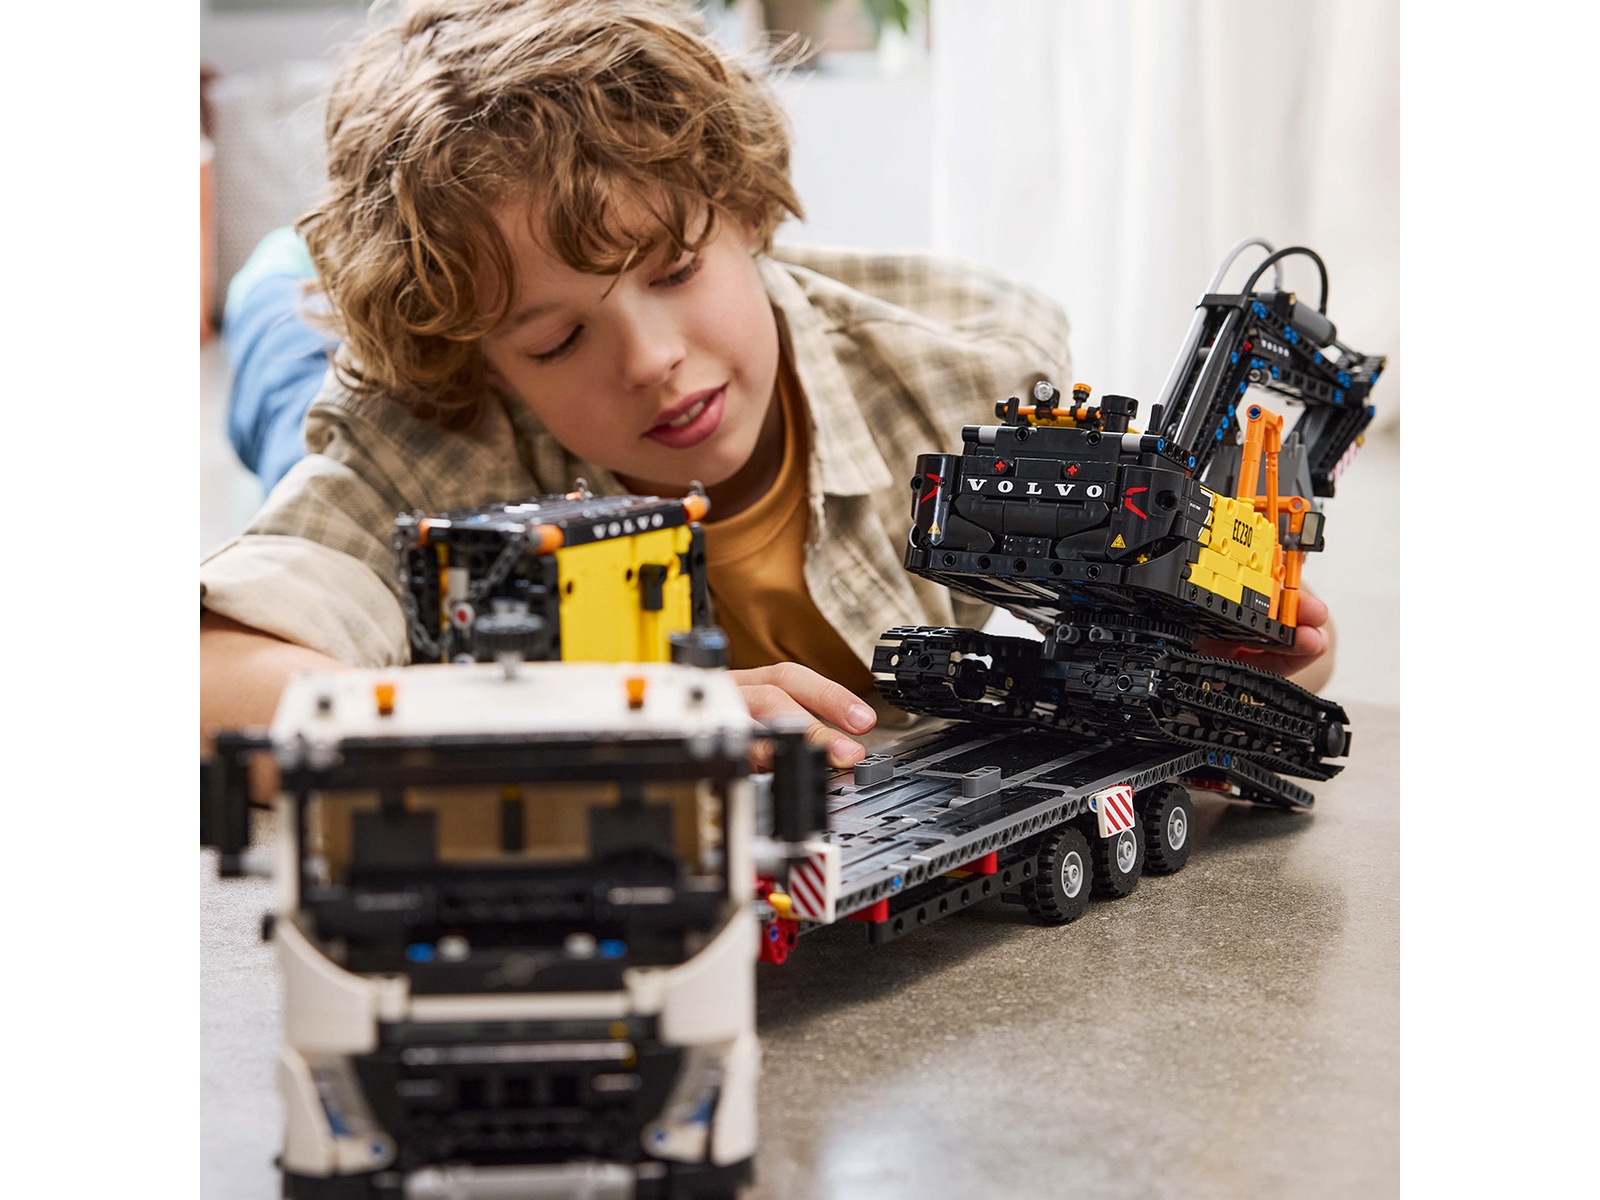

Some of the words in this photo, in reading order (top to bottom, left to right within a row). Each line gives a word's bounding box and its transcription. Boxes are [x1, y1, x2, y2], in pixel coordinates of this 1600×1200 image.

[967, 478, 1103, 498] VOLVO
[592, 513, 664, 540] VOLVO
[1232, 518, 1253, 548] EC230
